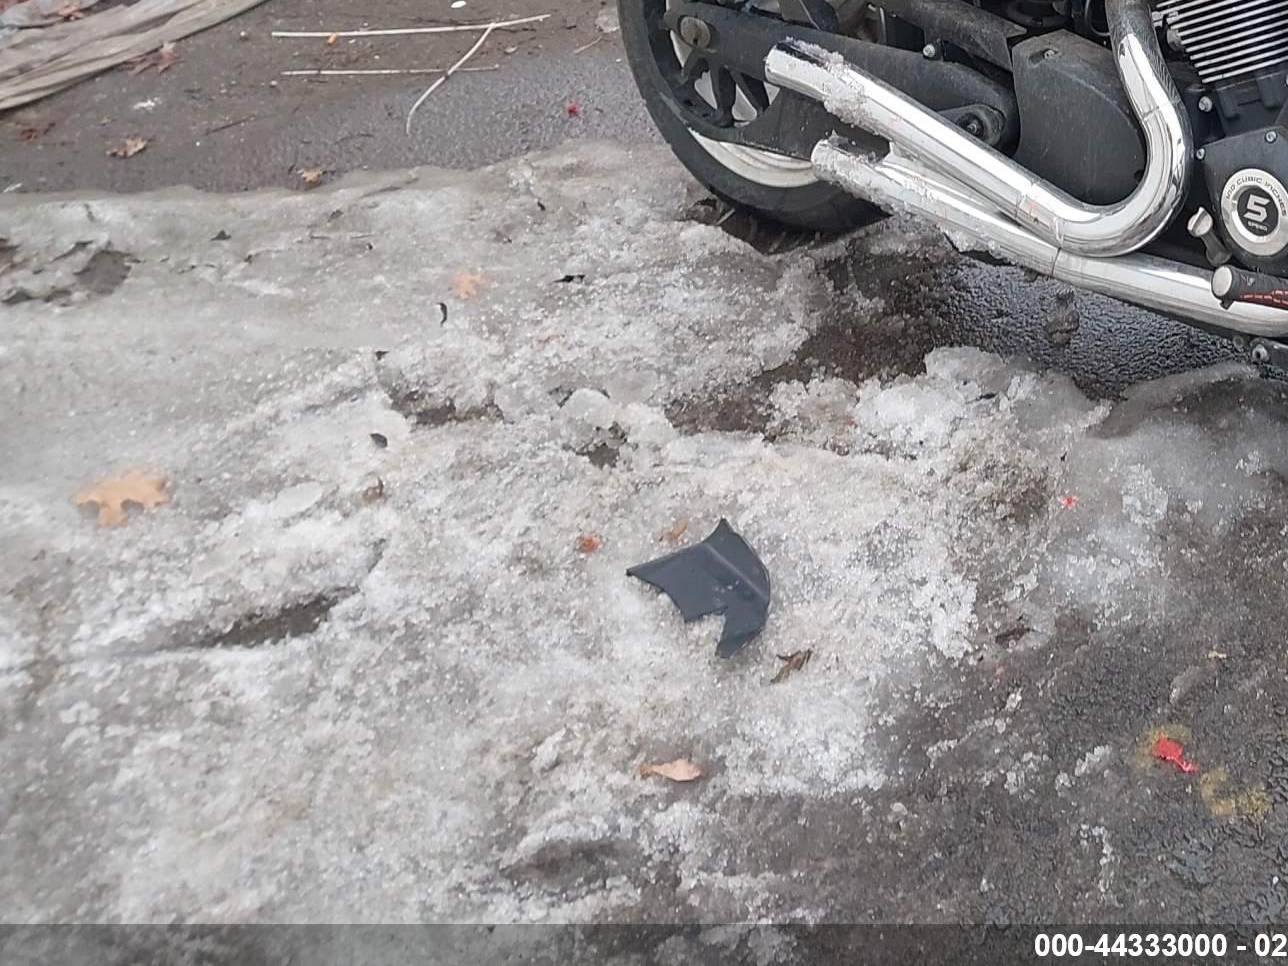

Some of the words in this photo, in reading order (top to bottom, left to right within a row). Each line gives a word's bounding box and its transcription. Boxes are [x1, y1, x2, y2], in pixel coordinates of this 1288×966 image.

[1236, 176, 1263, 186] CUBIC
[1264, 180, 1287, 217] INCHES
[1243, 193, 1271, 223] 5
